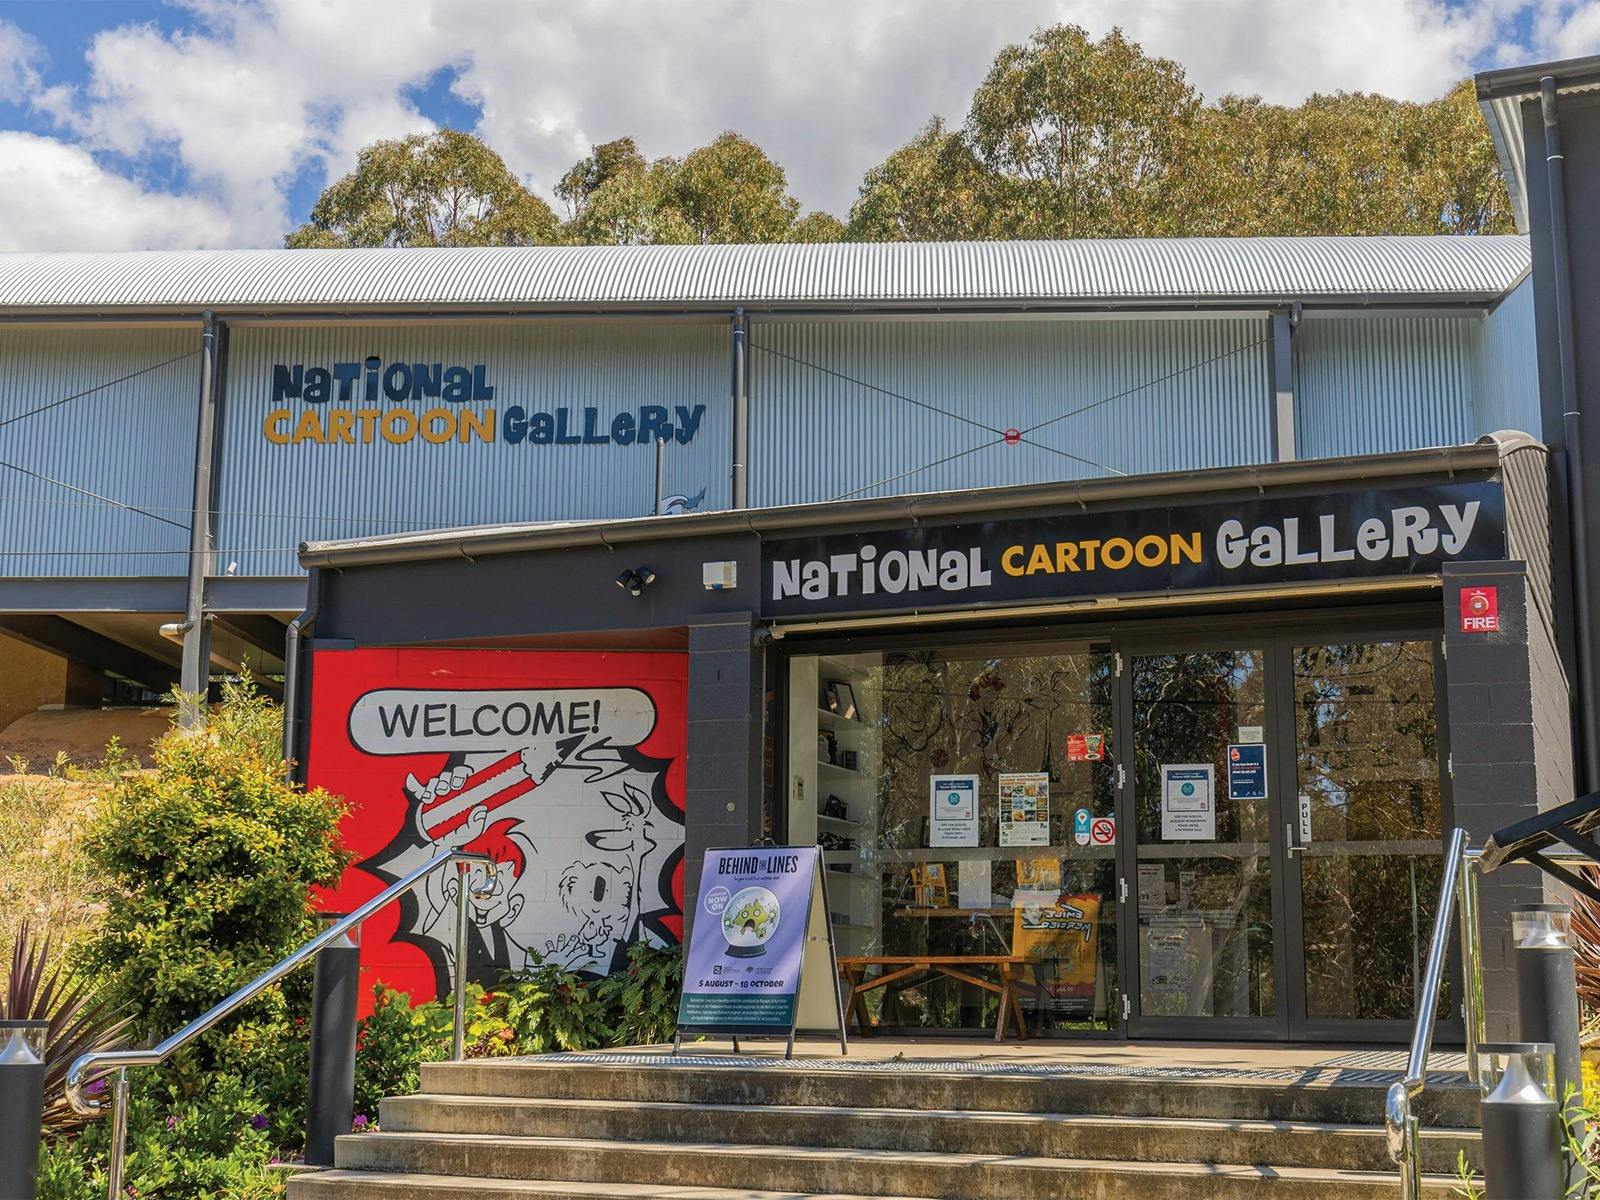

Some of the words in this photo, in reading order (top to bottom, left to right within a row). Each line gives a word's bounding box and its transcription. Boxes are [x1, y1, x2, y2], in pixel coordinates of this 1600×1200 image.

[264, 408, 497, 445] CARTOON
[1002, 532, 1203, 577] CARTOON
[1463, 616, 1496, 630] FIRE
[378, 699, 602, 738] WELCOME!
[1301, 803, 1309, 835] PULL
[719, 857, 758, 875] BEHIND
[767, 855, 798, 874] LINES
[708, 896, 728, 905] NOW
[711, 903, 724, 911] ON
[740, 980, 749, 988] 18
